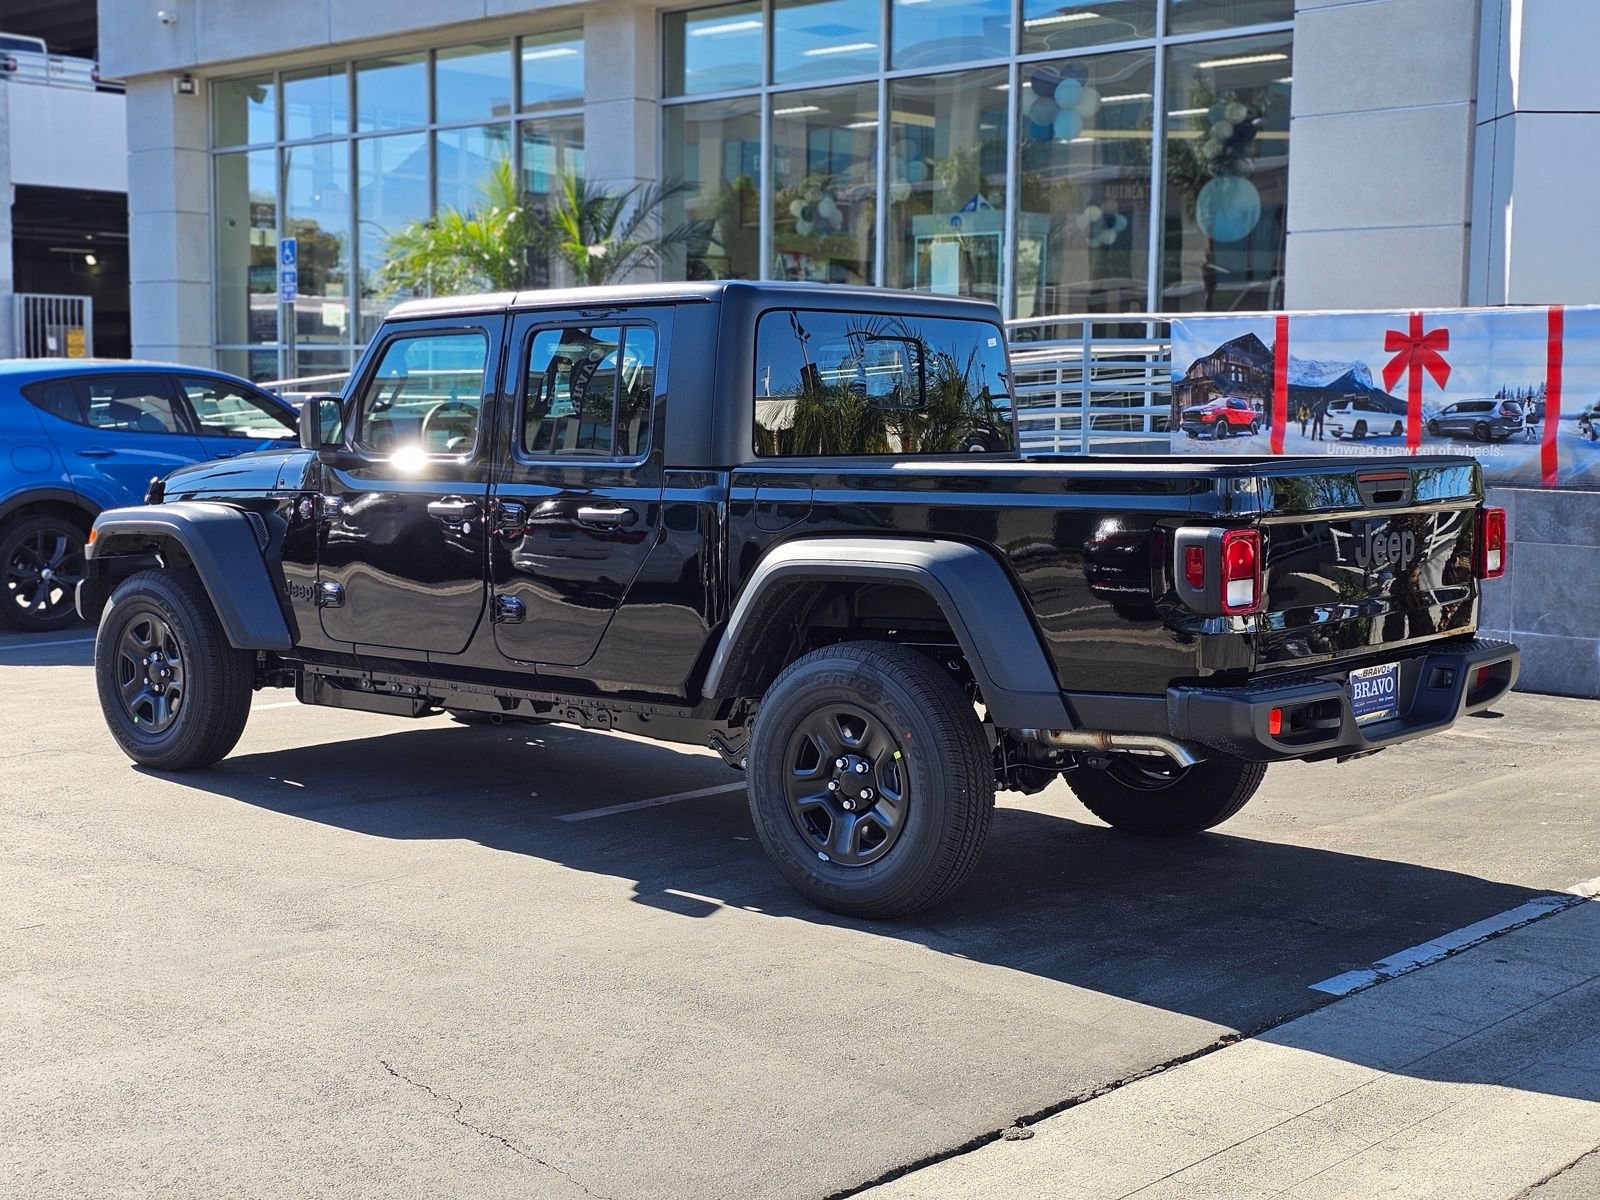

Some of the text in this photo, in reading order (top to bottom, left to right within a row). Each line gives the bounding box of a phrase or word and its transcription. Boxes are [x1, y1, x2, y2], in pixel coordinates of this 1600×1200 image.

[1326, 444, 1374, 456] Unwrap
[1381, 446, 1413, 456] new
[1415, 445, 1435, 456] set
[1439, 445, 1452, 456] of
[1355, 523, 1415, 571] Jeep
[284, 579, 313, 602] Jeep
[1362, 665, 1386, 677] BRAVO
[1353, 676, 1394, 700] BRAVO
